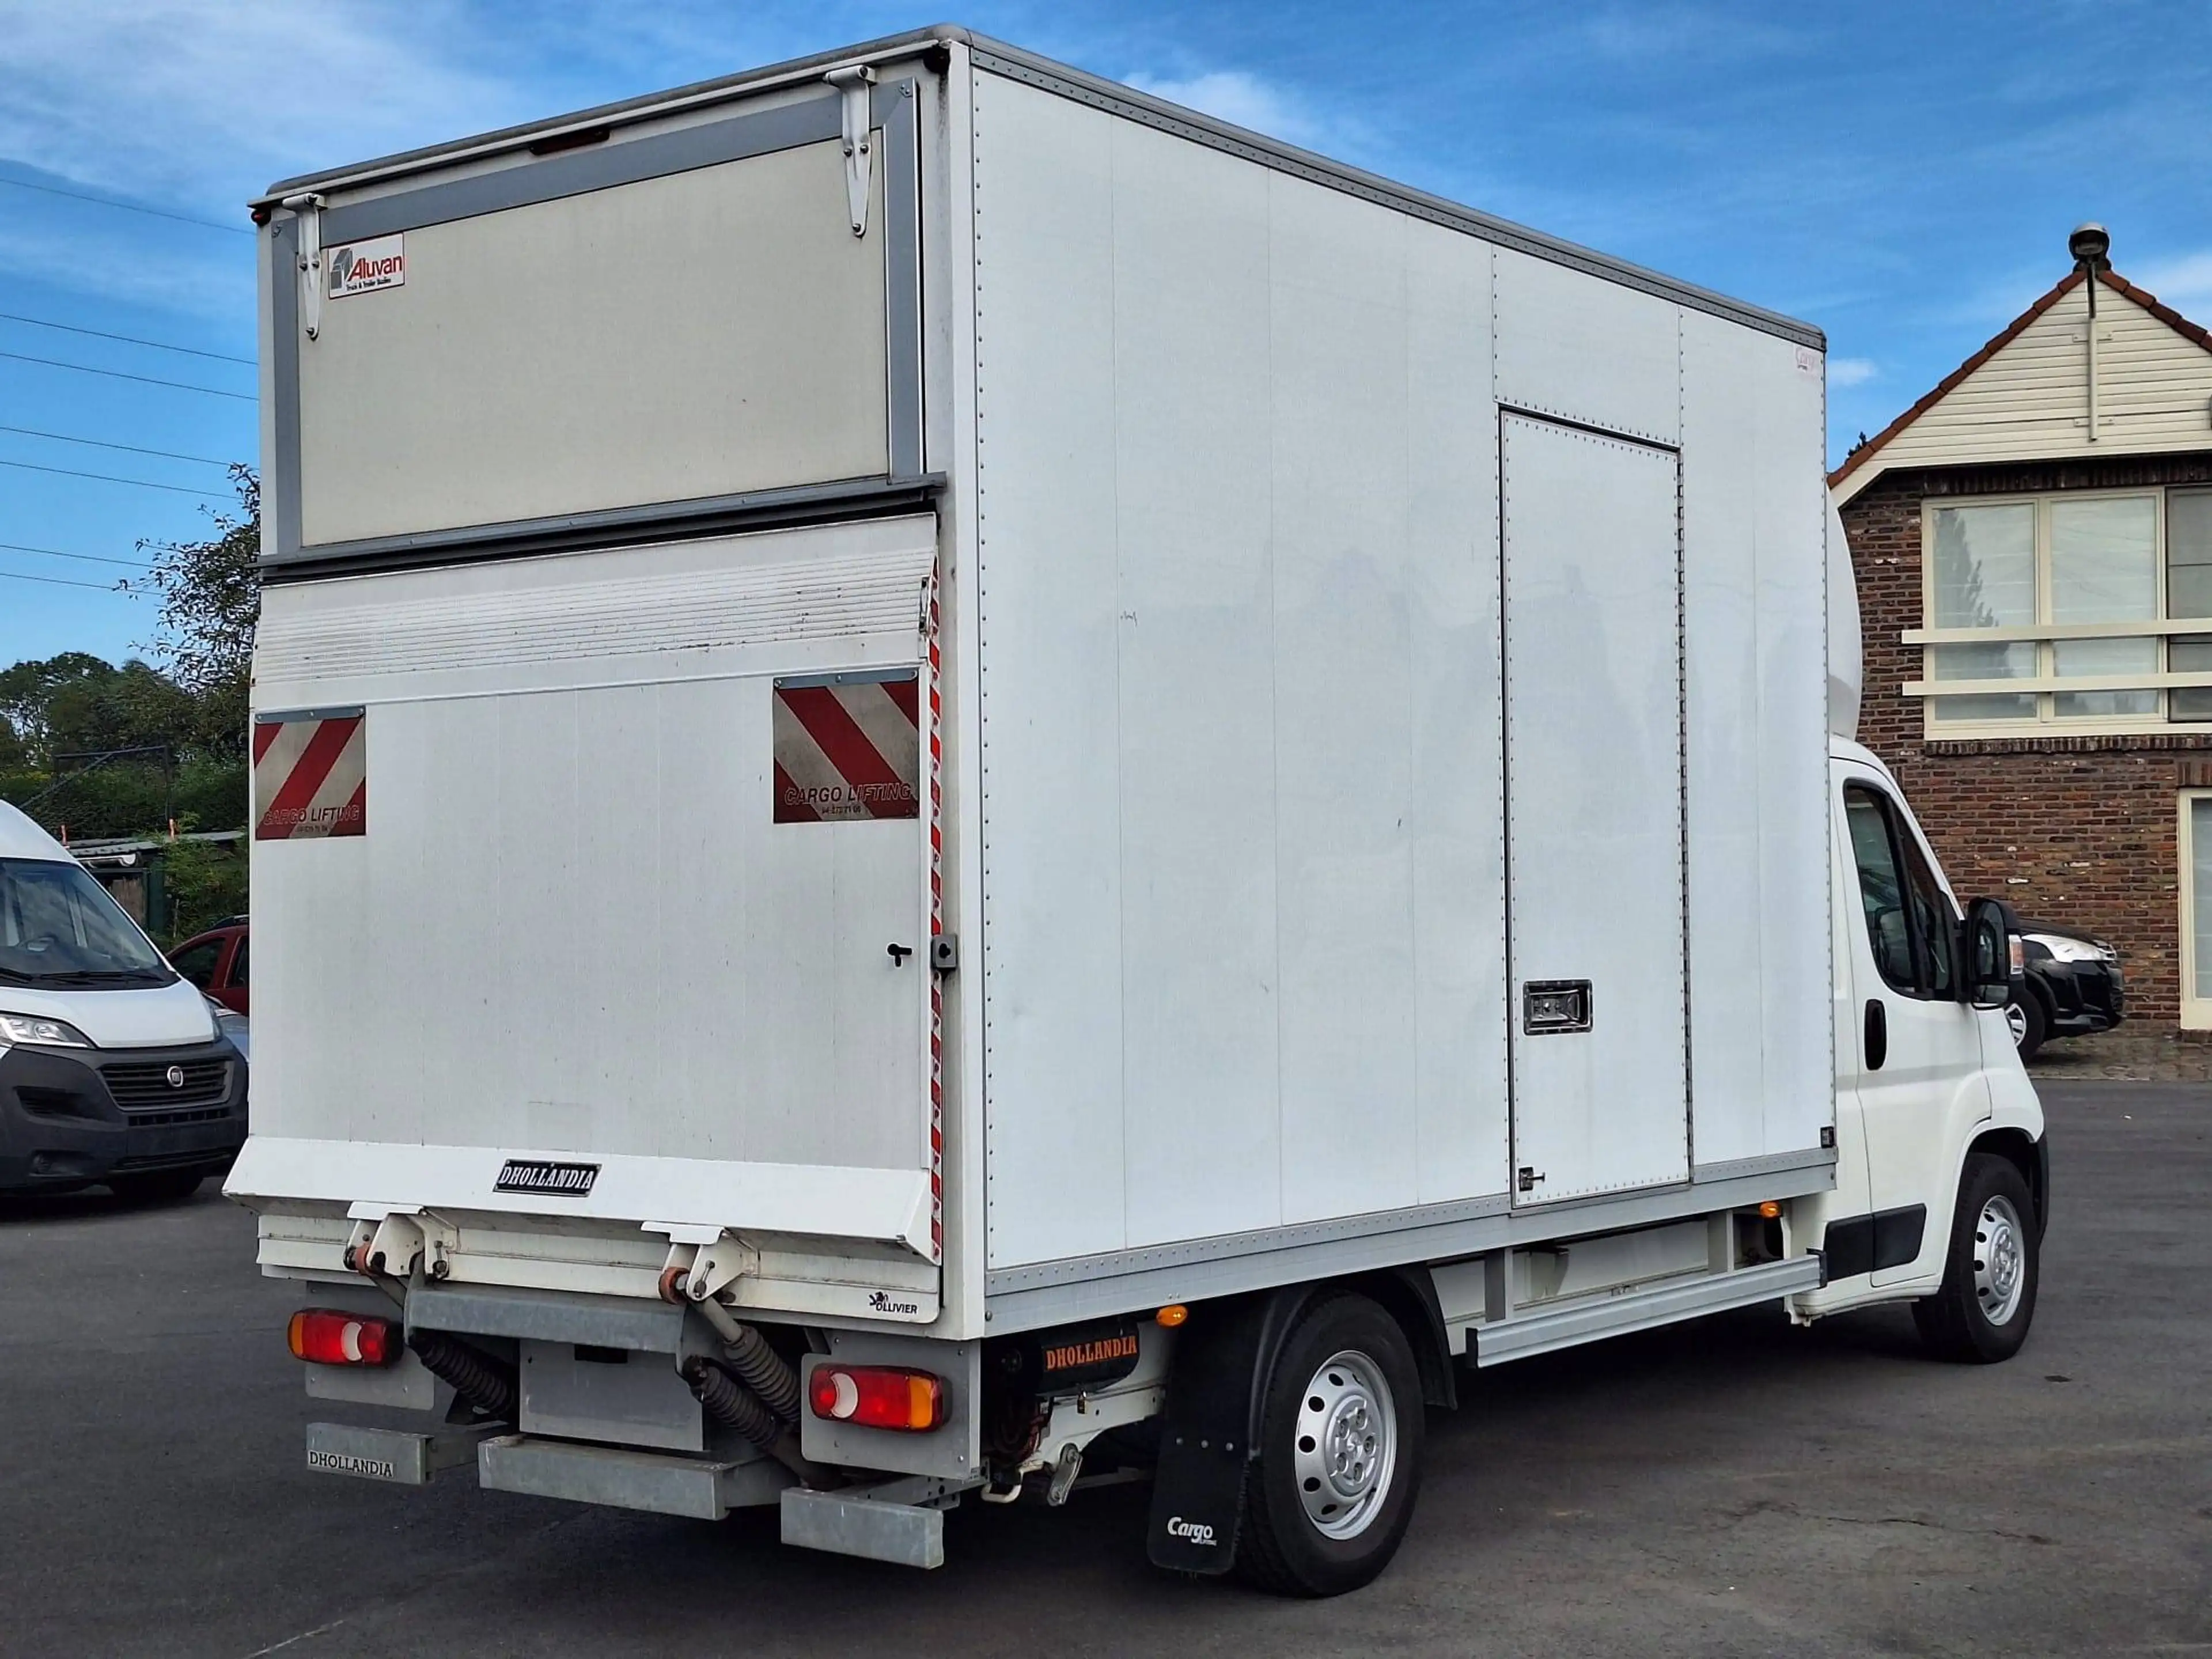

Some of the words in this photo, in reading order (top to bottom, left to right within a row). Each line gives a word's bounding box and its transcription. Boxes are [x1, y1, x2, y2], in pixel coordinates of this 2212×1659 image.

[347, 256, 402, 282] Aluvan
[785, 787, 842, 806] CARGO
[848, 782, 912, 802] LIFTING
[263, 807, 306, 825] CARGO
[311, 805, 359, 822] LIFTING
[499, 1165, 594, 1189] DHOLLANDIA
[876, 1302, 917, 1314] OLLIVIER
[1046, 1336, 1137, 1369] DHOLLANDIA
[309, 1451, 393, 1478] DHOLLANDIA
[1167, 1516, 1214, 1544] Cargo
